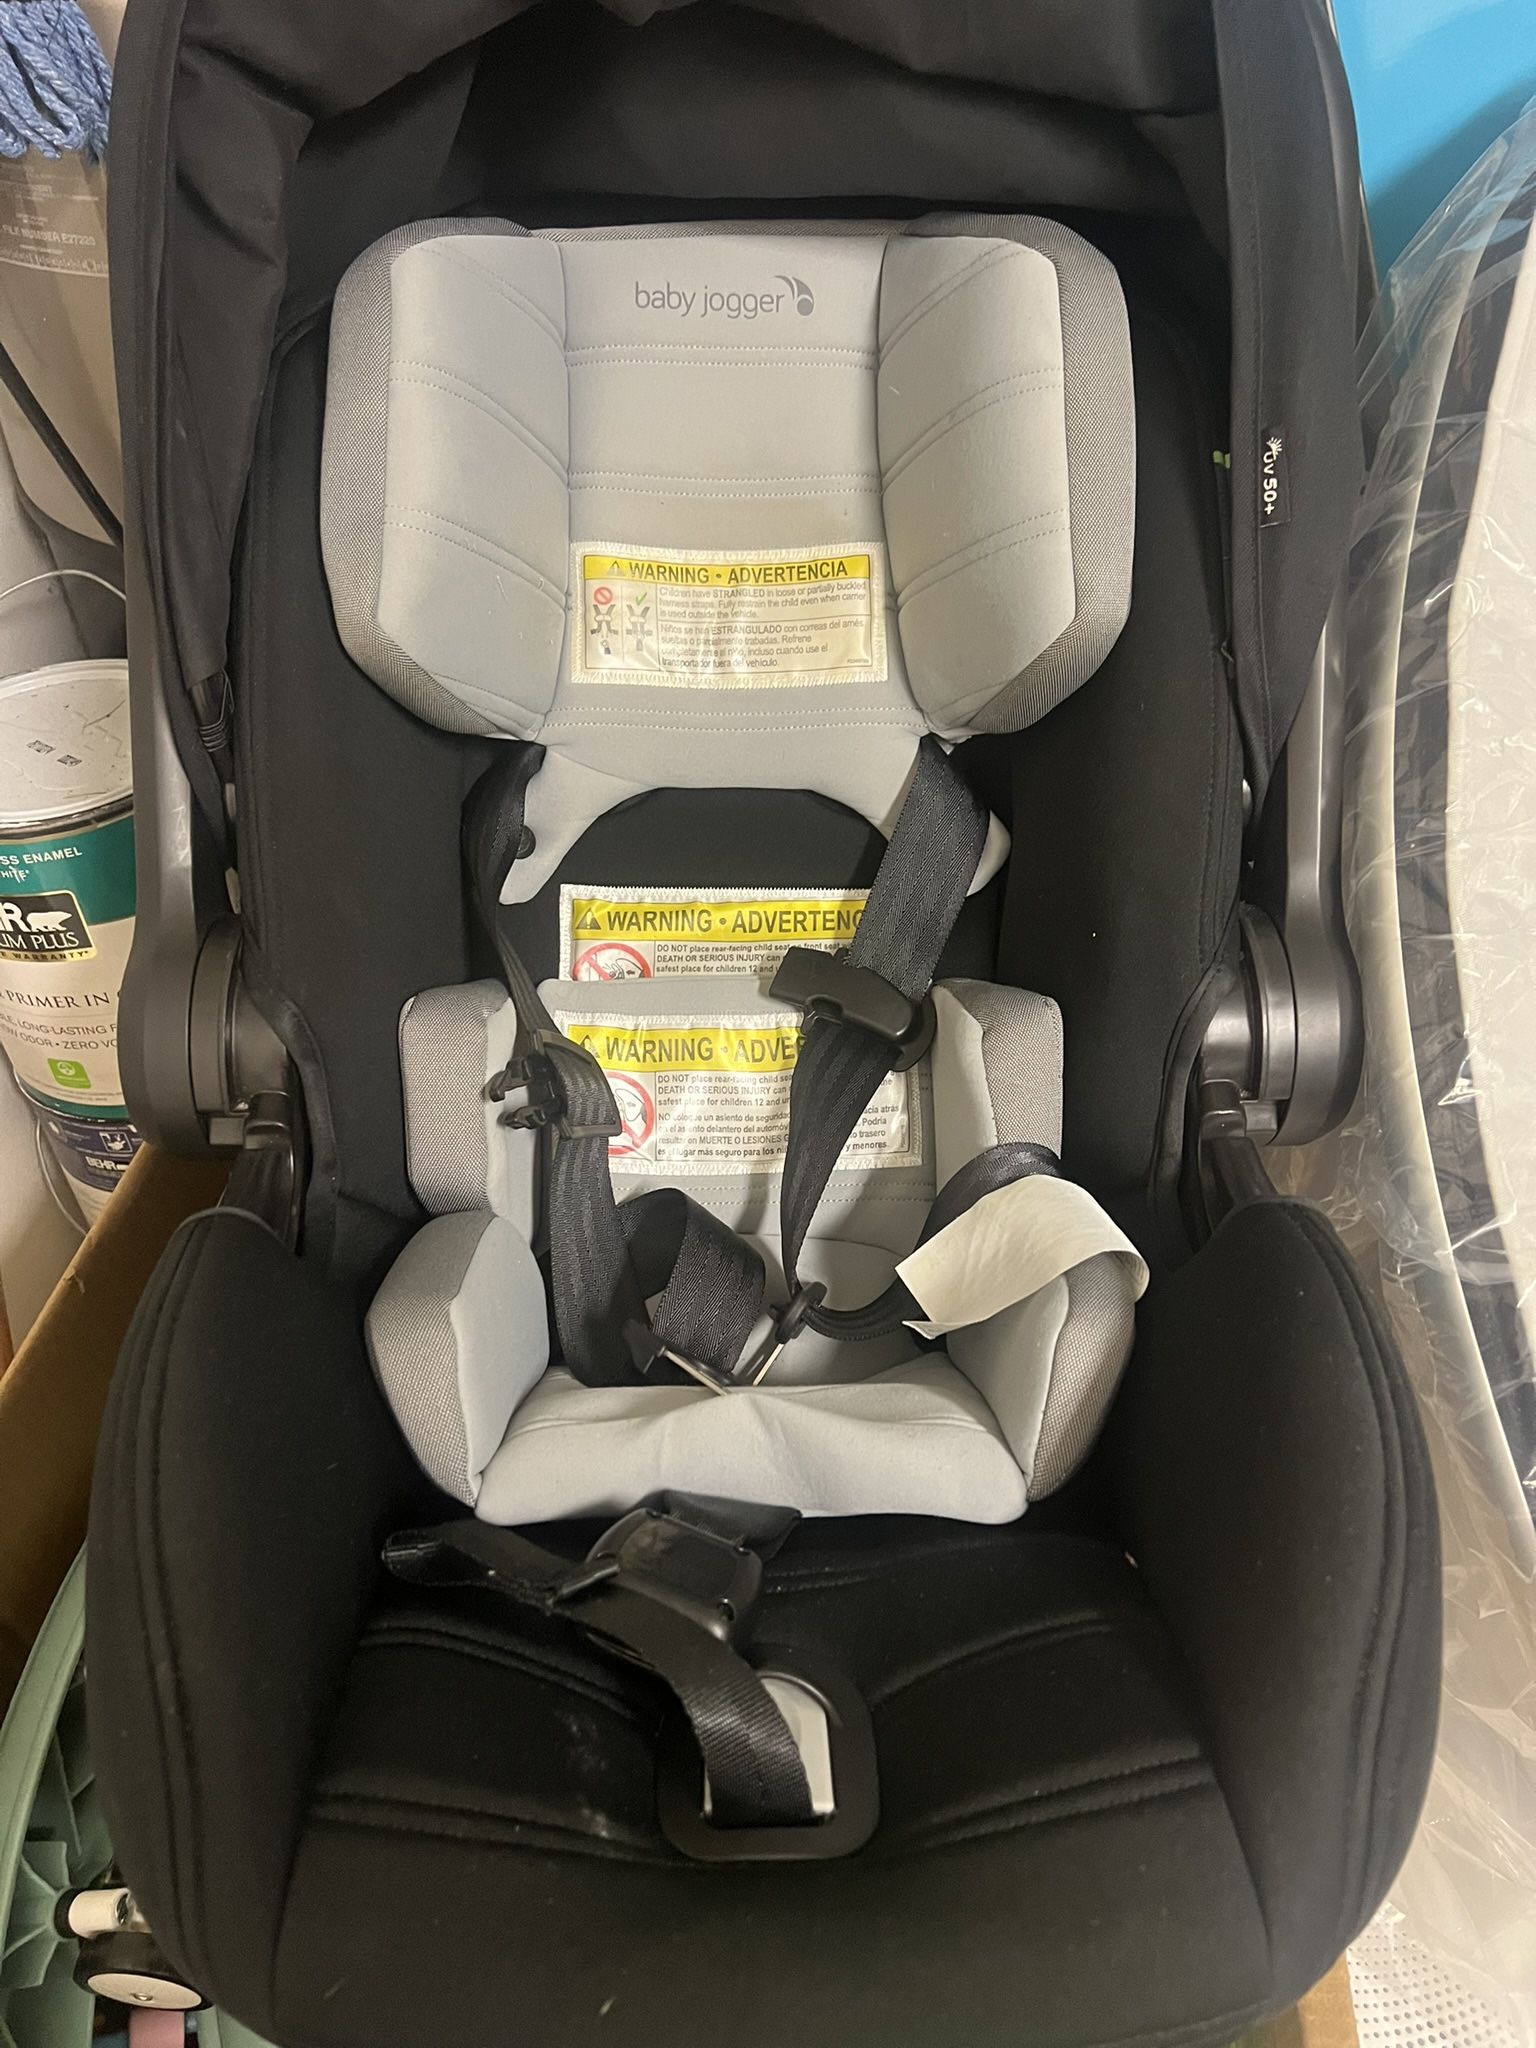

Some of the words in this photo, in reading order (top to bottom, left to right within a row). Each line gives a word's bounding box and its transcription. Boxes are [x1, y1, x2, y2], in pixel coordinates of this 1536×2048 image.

[635, 280, 697, 317] baby
[700, 284, 785, 320] jogger
[1263, 477, 1278, 515] 50+
[629, 563, 709, 584] WARNING
[728, 560, 848, 585] ADVERTENCIA
[660, 587, 691, 598] Children
[692, 588, 711, 598] have
[712, 587, 765, 599] STRANGLED
[767, 589, 774, 597] in
[776, 588, 796, 597] loose
[798, 588, 805, 596] or
[807, 583, 836, 595] partially
[837, 581, 866, 591] buckled
[768, 599, 779, 607] the
[781, 597, 799, 607] child
[800, 597, 819, 605] even
[820, 594, 840, 603] when
[667, 610, 687, 618] used
[717, 610, 729, 618] the
[712, 624, 782, 636] ESTRANGULADO
[783, 625, 798, 633] con
[829, 619, 841, 629] del
[776, 645, 804, 655] cuando
[805, 645, 820, 654] use
[820, 642, 829, 653] el
[22, 846, 83, 864] ENAMEL
[606, 908, 713, 934] WARNING
[30, 931, 80, 950] PLUS
[657, 944, 670, 953] DO
[671, 944, 688, 953] NOT
[689, 944, 710, 954] place
[711, 943, 753, 954] rear-facing
[754, 942, 773, 951] child
[774, 942, 791, 951] seat
[656, 954, 683, 963] DEATH
[685, 954, 698, 963] OR
[699, 953, 735, 962] SERIOUS
[736, 953, 765, 962] INJURY
[766, 954, 781, 962] can
[656, 965, 679, 973] safest
[680, 964, 701, 974] place
[703, 964, 714, 973] for
[715, 964, 746, 973] children
[748, 964, 757, 973] 12
[759, 965, 774, 973] and
[5, 989, 80, 1009] PRIMER
[83, 991, 110, 1007] IN
[62, 1040, 99, 1050] ZERO
[606, 1037, 713, 1063] WARNING
[657, 1074, 670, 1084] DO
[672, 1073, 690, 1083] NOT
[758, 1073, 778, 1084] child
[657, 1086, 686, 1095] DEATH
[688, 1085, 700, 1094] OR
[702, 1085, 739, 1095] SERIOUS
[741, 1085, 771, 1096] INJURY
[773, 1086, 787, 1095] can
[658, 1098, 682, 1107] safest
[706, 1097, 718, 1106] for
[720, 1097, 753, 1107] children
[755, 1098, 764, 1107] 12
[765, 1096, 780, 1106] and
[658, 1112, 671, 1121] NO
[703, 1114, 714, 1122] un
[715, 1112, 743, 1122] asiento
[744, 1112, 754, 1122] de
[864, 1106, 879, 1114] acia
[706, 1123, 742, 1133] delantero
[743, 1123, 755, 1133] del
[755, 1122, 788, 1133] automóv
[862, 1116, 887, 1126] Podría
[698, 1135, 733, 1145] MUERTE
[734, 1135, 741, 1144] O
[742, 1134, 782, 1145] LESIONES
[859, 1129, 886, 1138] trasero
[697, 1146, 714, 1156] más
[714, 1147, 742, 1158] seguro
[743, 1148, 760, 1158] para
[762, 1147, 775, 1156] los
